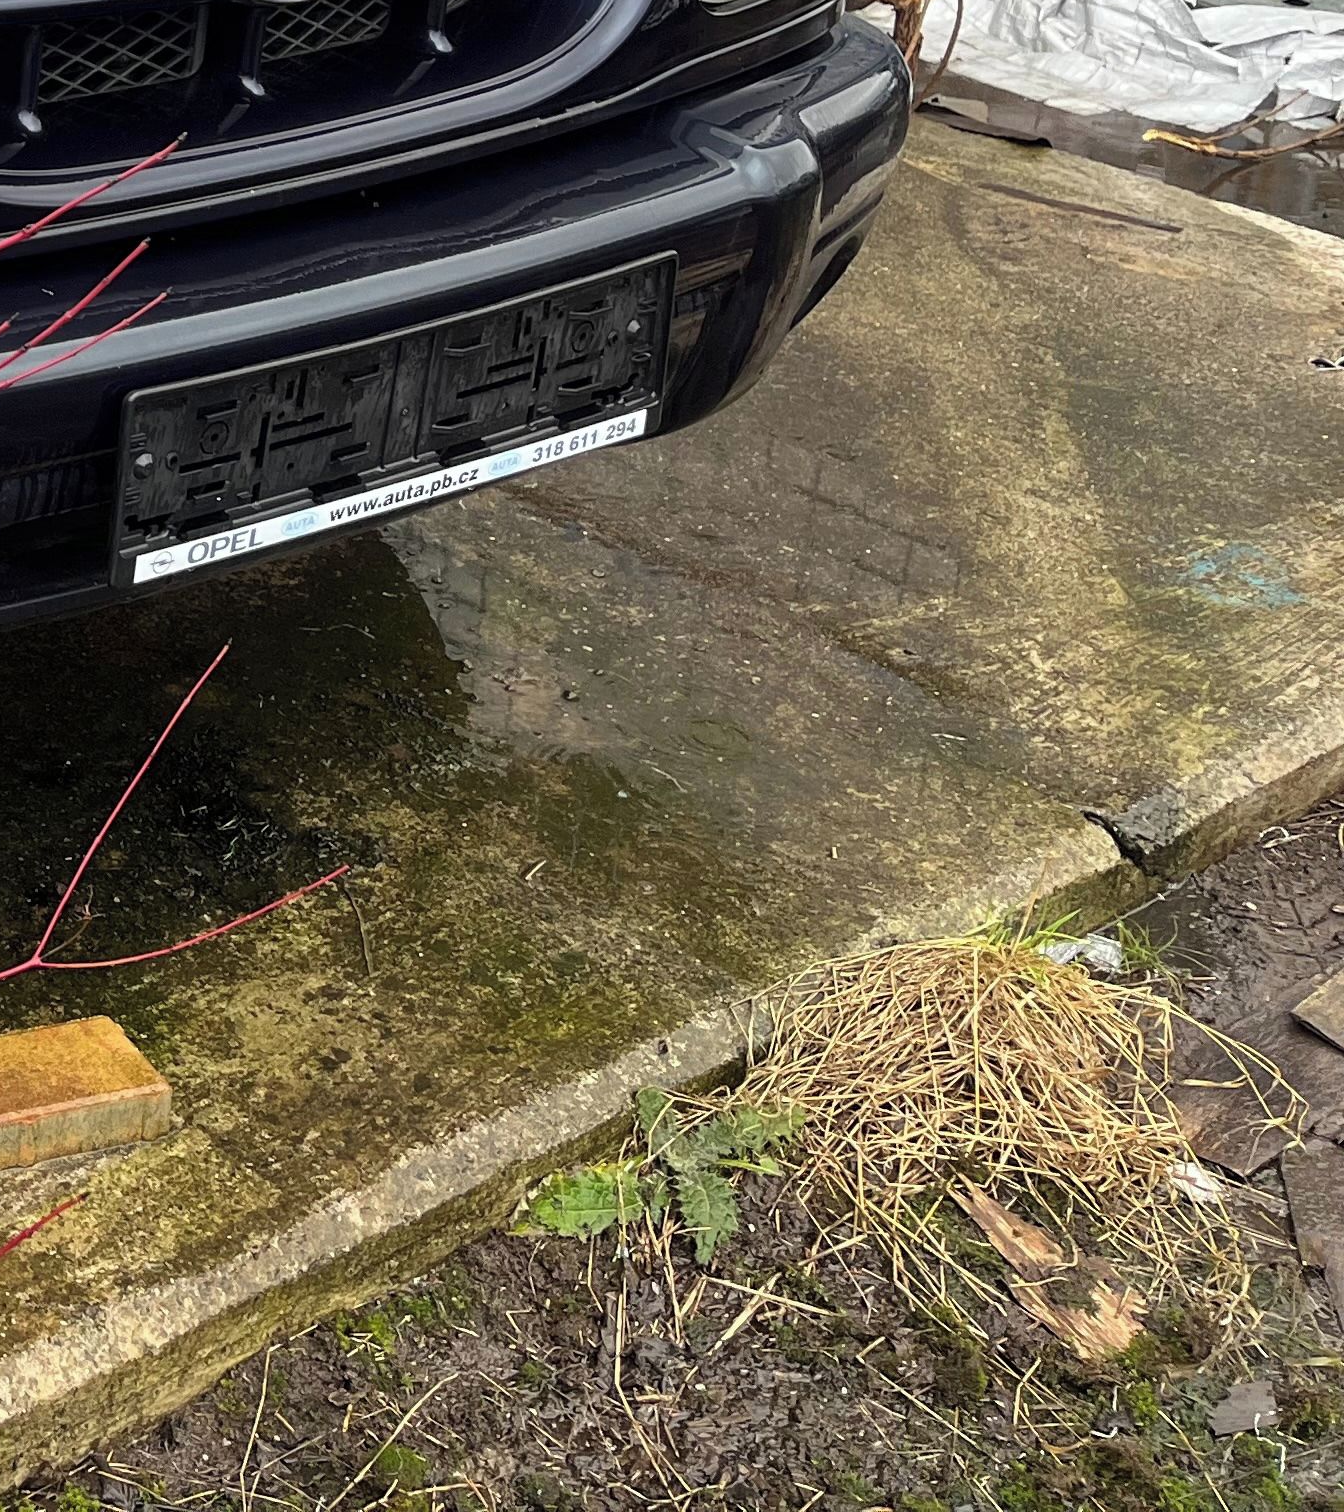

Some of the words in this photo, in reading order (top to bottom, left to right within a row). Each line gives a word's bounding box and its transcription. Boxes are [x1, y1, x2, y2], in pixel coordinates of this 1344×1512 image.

[187, 528, 263, 564] OPEL
[284, 515, 316, 533] AUTA
[330, 468, 479, 521] www.auta.pb.cz
[491, 454, 519, 471] AUTA
[532, 441, 564, 463] 318
[569, 429, 598, 452] 611
[605, 418, 636, 441] 294
